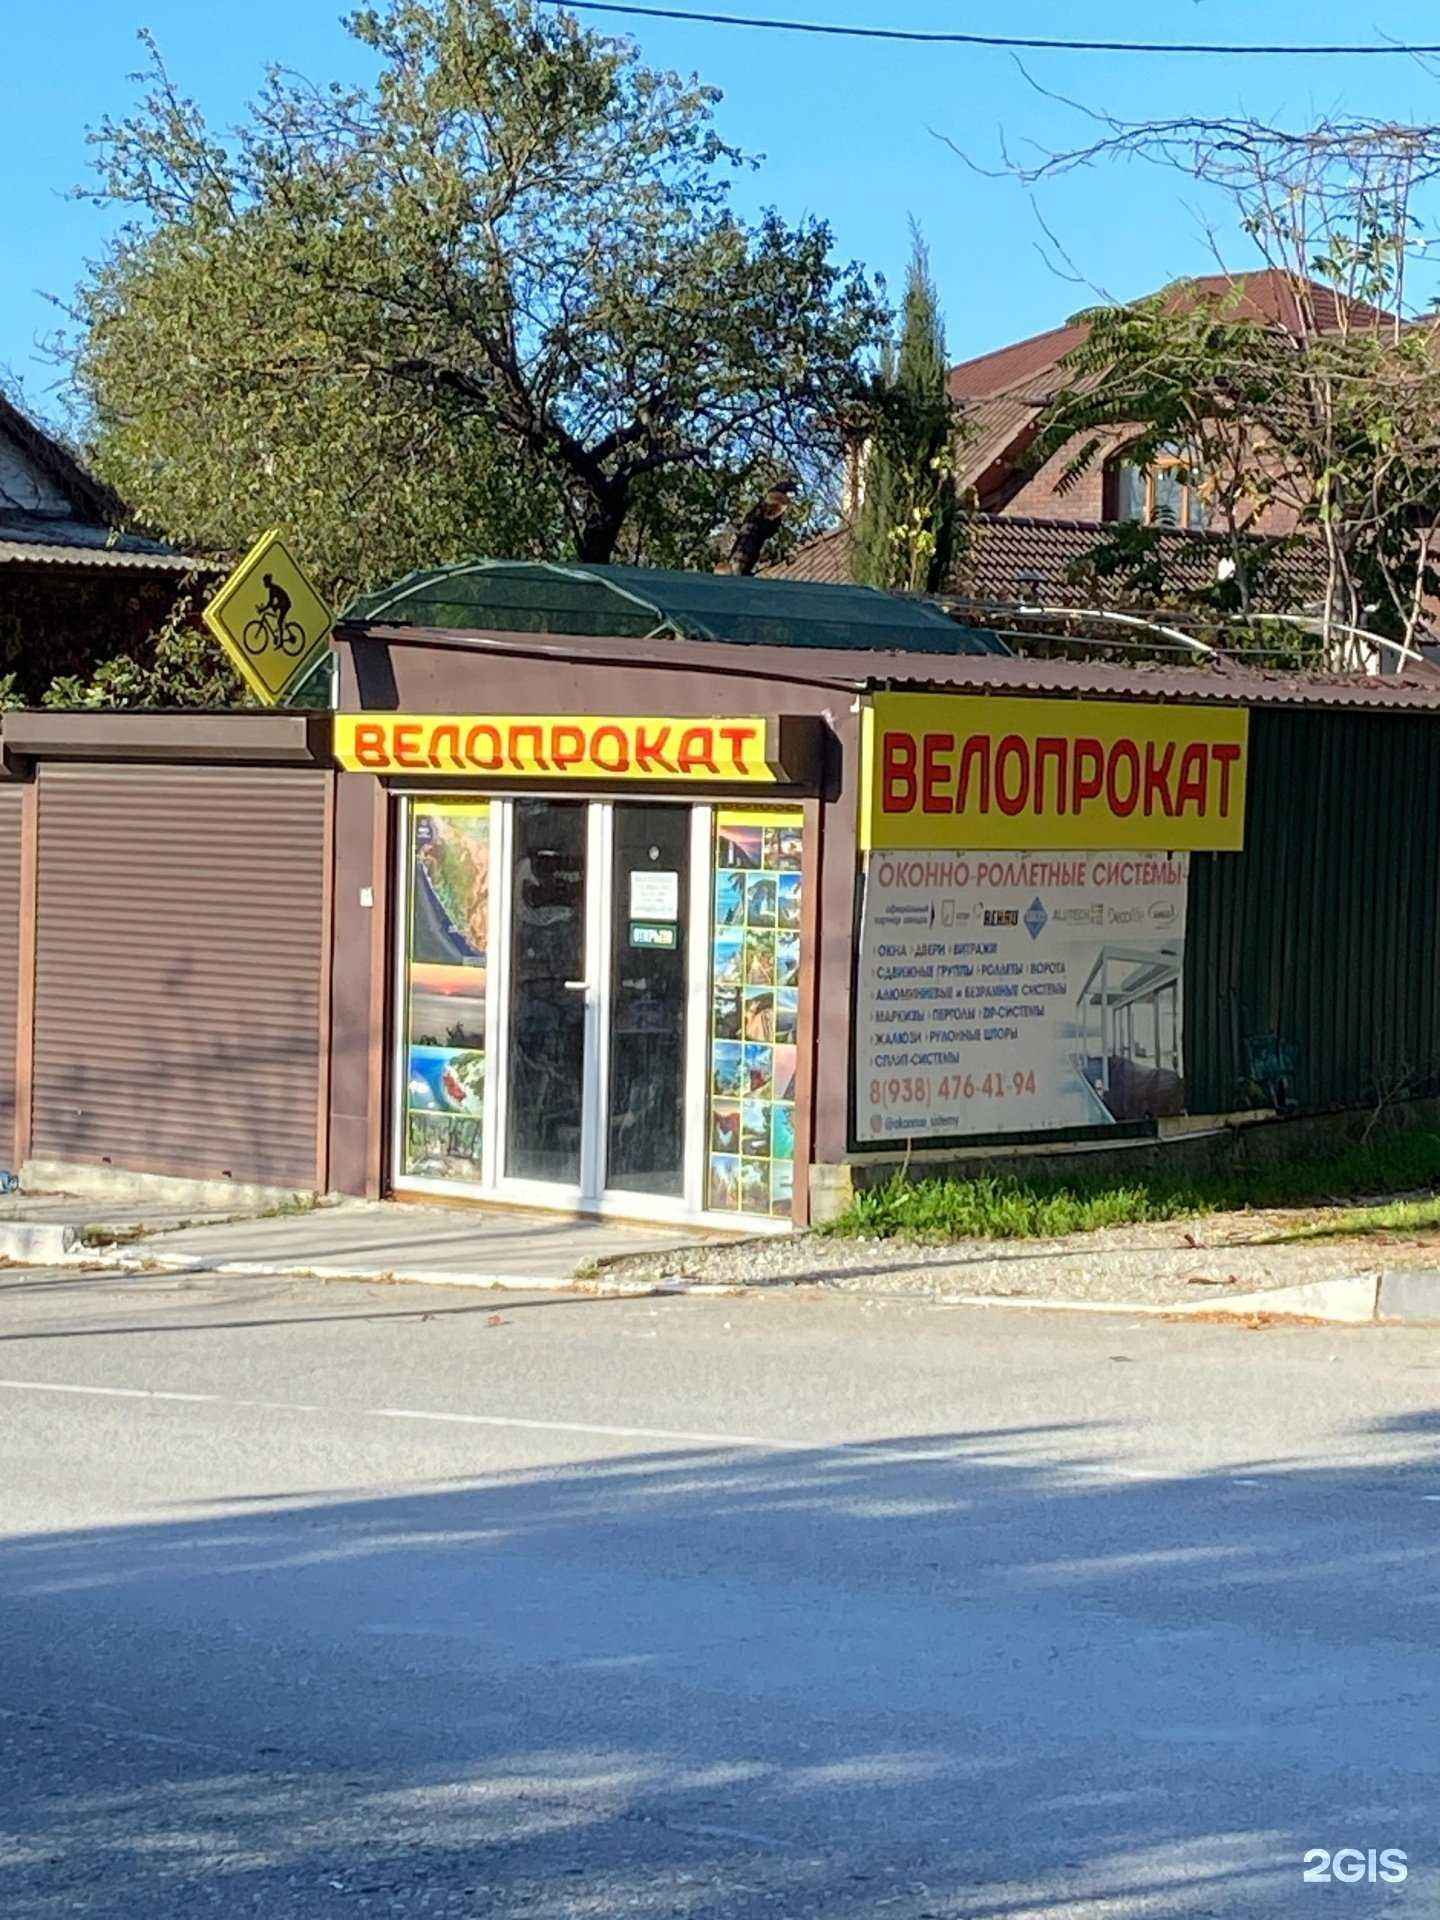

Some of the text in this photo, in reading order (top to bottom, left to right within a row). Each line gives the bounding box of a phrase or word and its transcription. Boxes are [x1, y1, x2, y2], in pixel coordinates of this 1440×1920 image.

[354, 723, 756, 775] ВЕЛОПРОКАТ
[882, 732, 1241, 818] ВЕЛОПРОКАТ
[878, 861, 1182, 888] ОКОННО-РОЛЛЕТНЫЕ СИСТЕМЫ
[869, 1069, 1037, 1110] 8(938) 476-41-94
